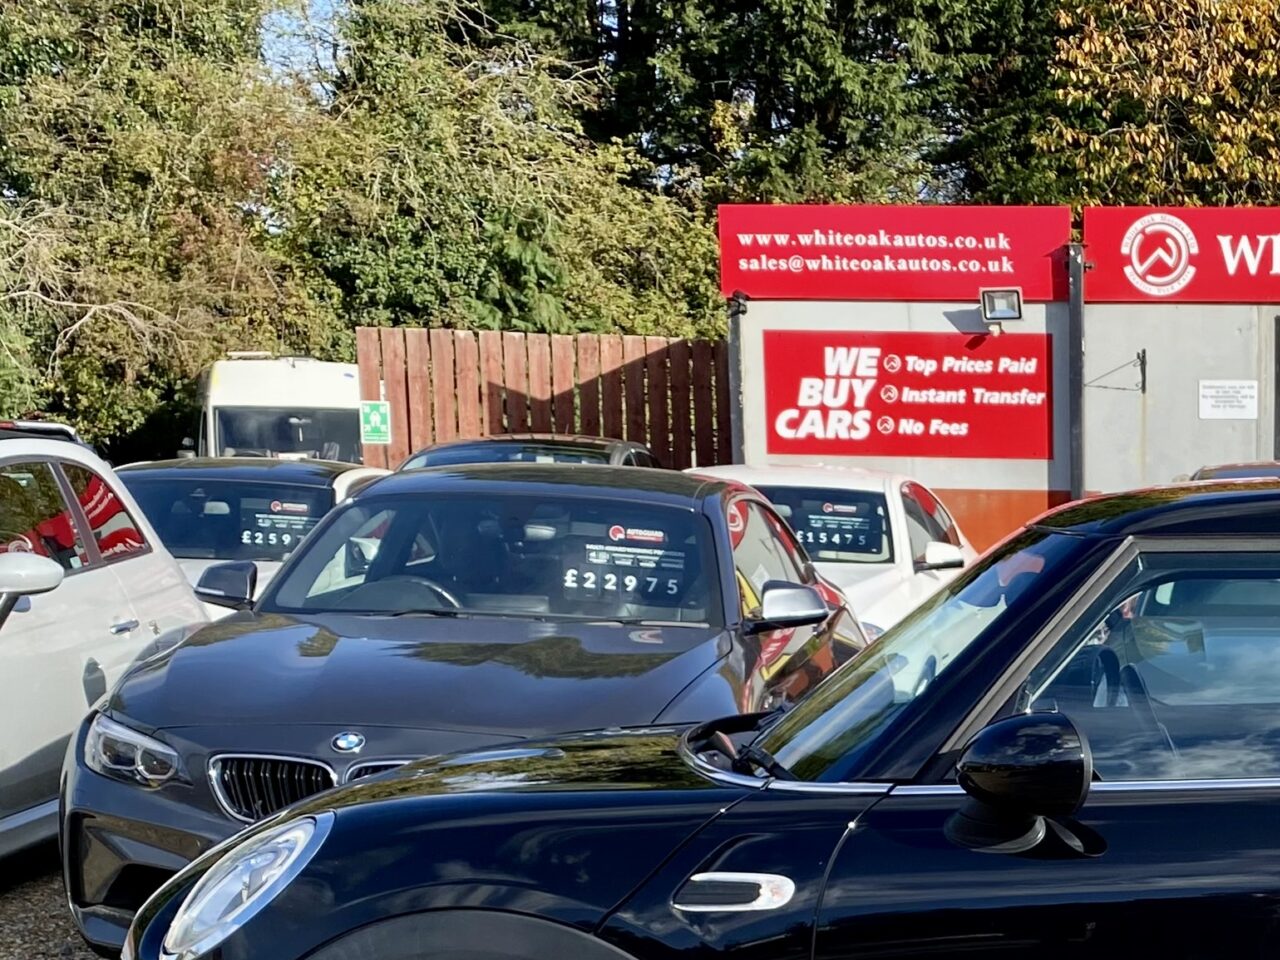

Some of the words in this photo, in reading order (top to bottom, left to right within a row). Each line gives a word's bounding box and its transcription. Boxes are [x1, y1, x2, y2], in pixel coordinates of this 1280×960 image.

[737, 230, 1011, 250] www.whiteoakautos.co.uk
[738, 254, 1014, 274] sales@whiteoakautos.co.uk
[824, 346, 882, 377] WE
[904, 355, 937, 375] Top
[942, 355, 993, 374] Prices
[998, 357, 1038, 374] Paid
[797, 377, 877, 409] BUY
[901, 388, 967, 405] Instant
[974, 388, 1046, 406] Transfer
[775, 408, 872, 440] CARS
[899, 418, 925, 435] No
[929, 419, 969, 436] Fees
[563, 568, 678, 595] £22975
